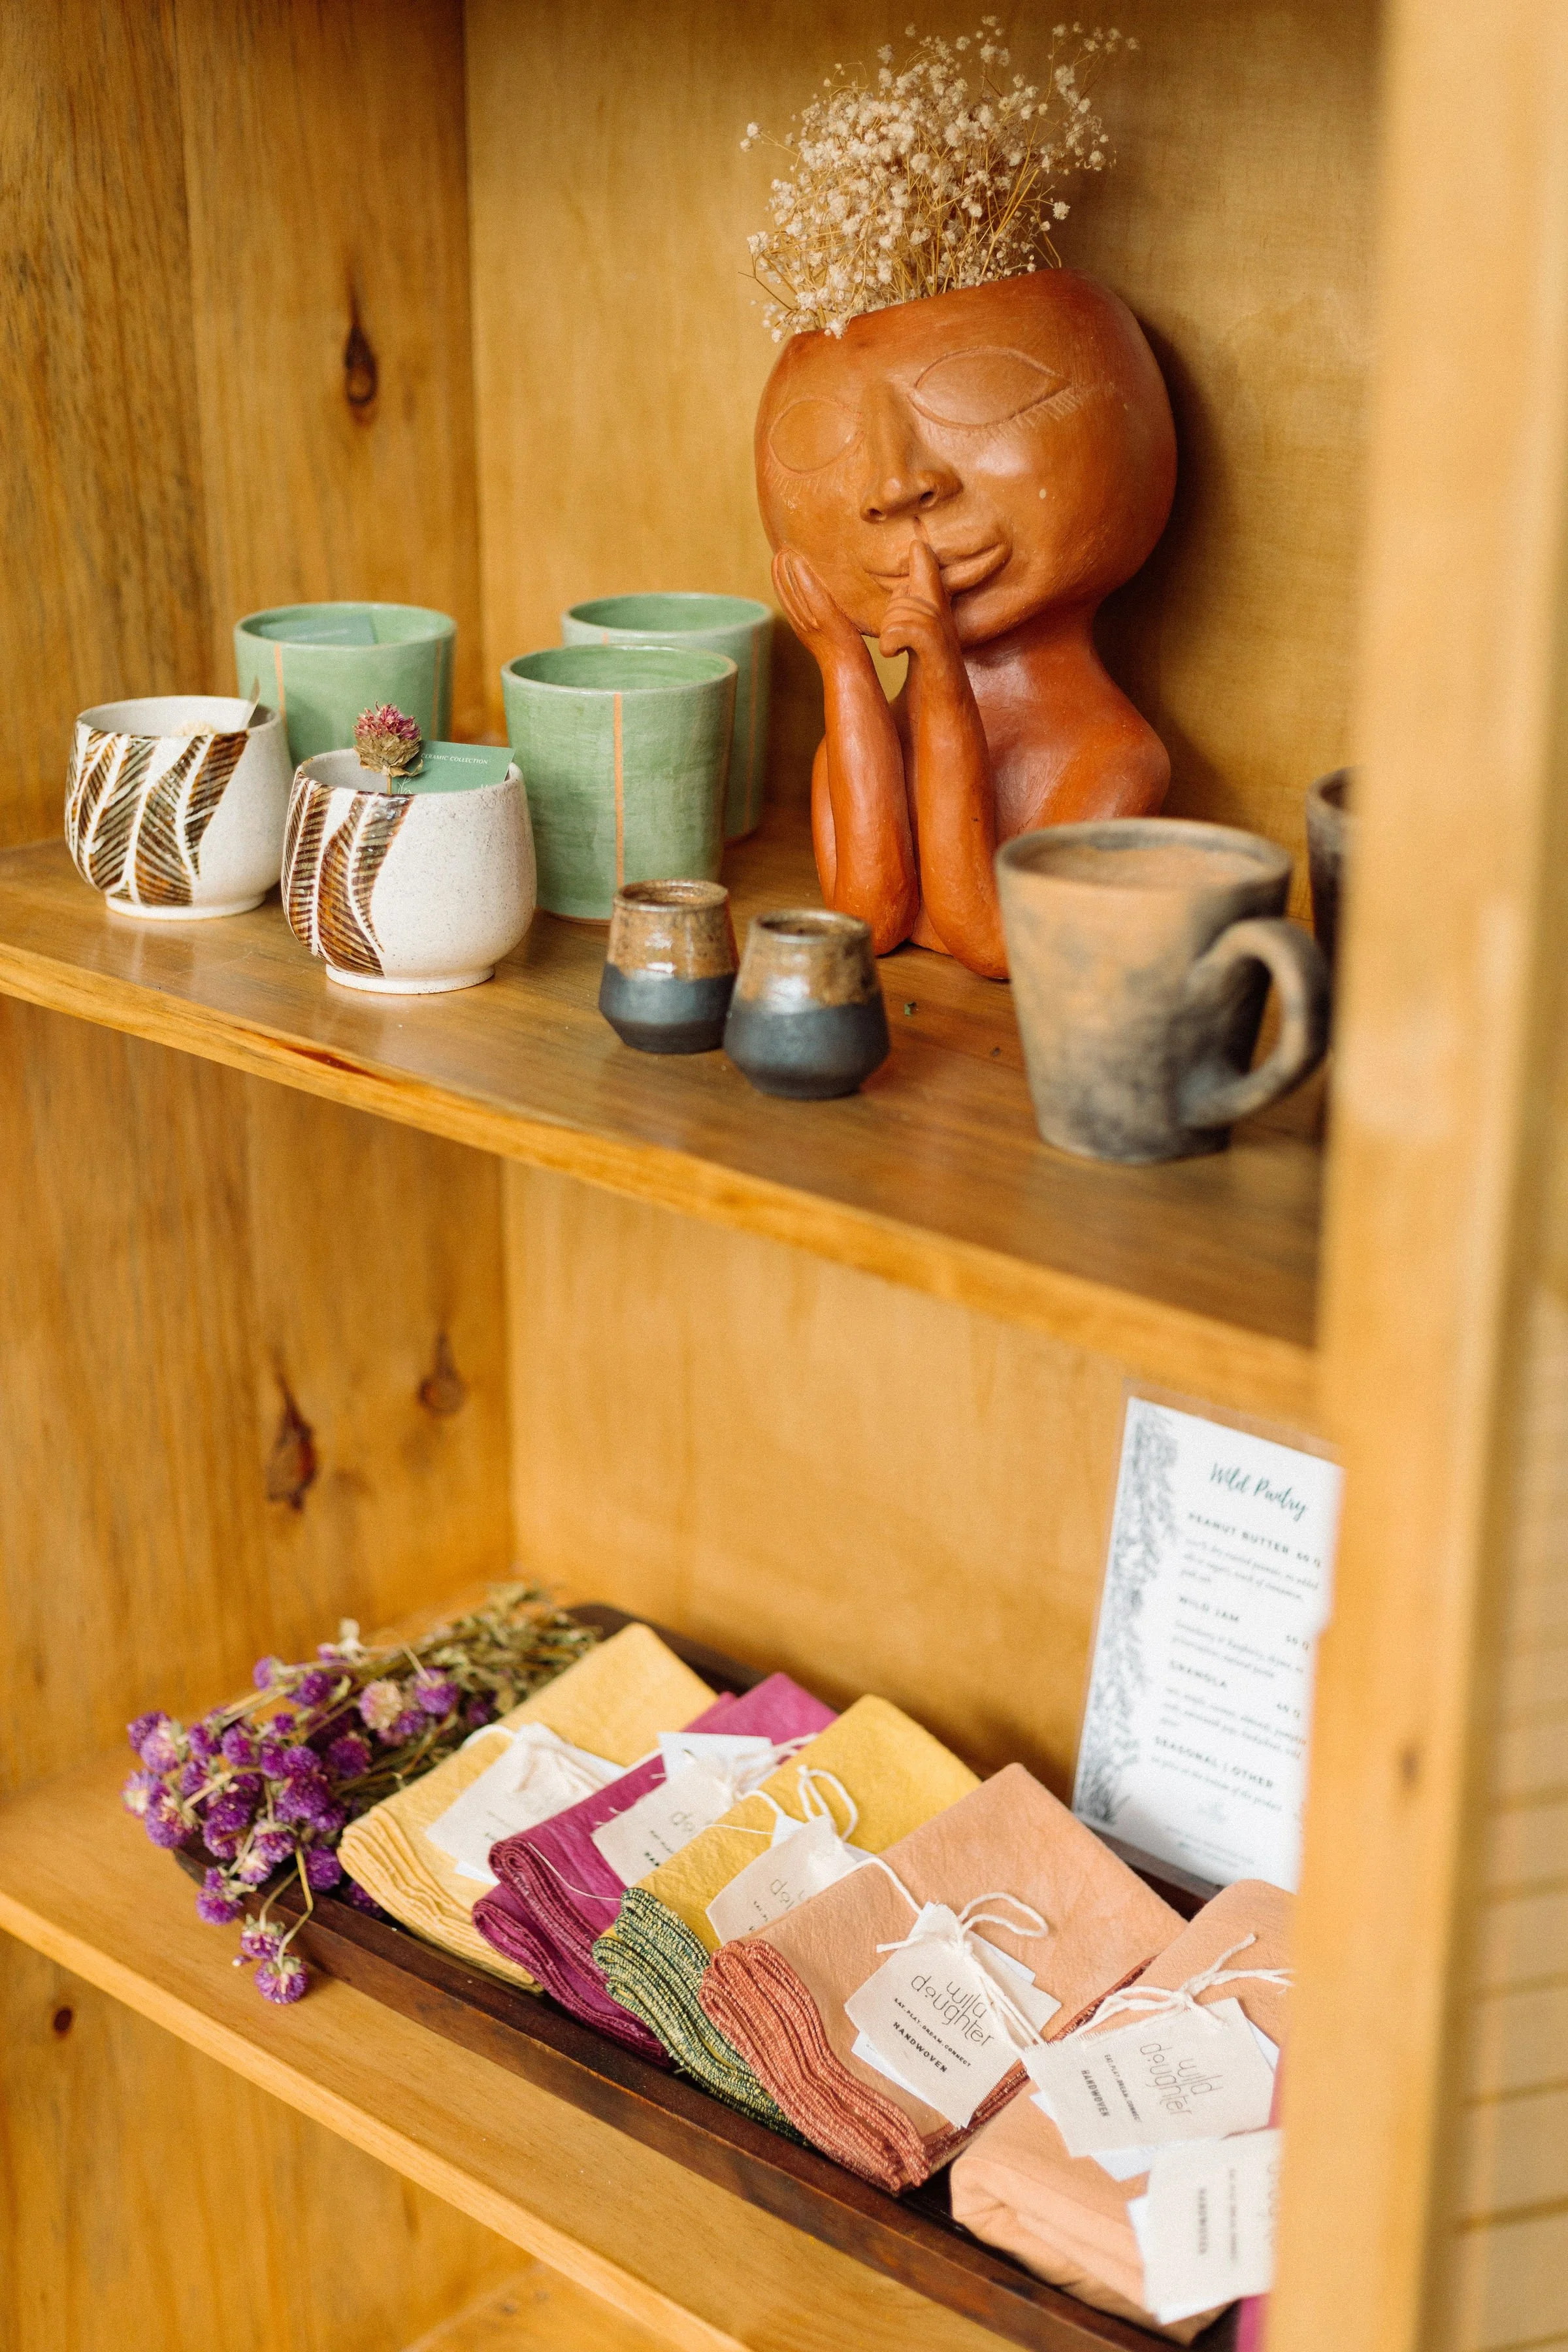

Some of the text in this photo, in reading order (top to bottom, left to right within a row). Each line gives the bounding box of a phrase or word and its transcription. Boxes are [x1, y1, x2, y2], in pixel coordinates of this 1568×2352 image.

[421, 753, 449, 761] CERAMIC
[1210, 1463, 1307, 1522] Wild Pantry
[1188, 1512, 1235, 1535] PEANUT
[1242, 1531, 1289, 1554] BUTTER
[1232, 1765, 1273, 1788] OTHER
[911, 1975, 995, 2046] daughter
[893, 2021, 947, 2072] HANDWOVEN
[1081, 2069, 1110, 2117] HANDWOVEN
[1140, 2044, 1192, 2115] daughter
